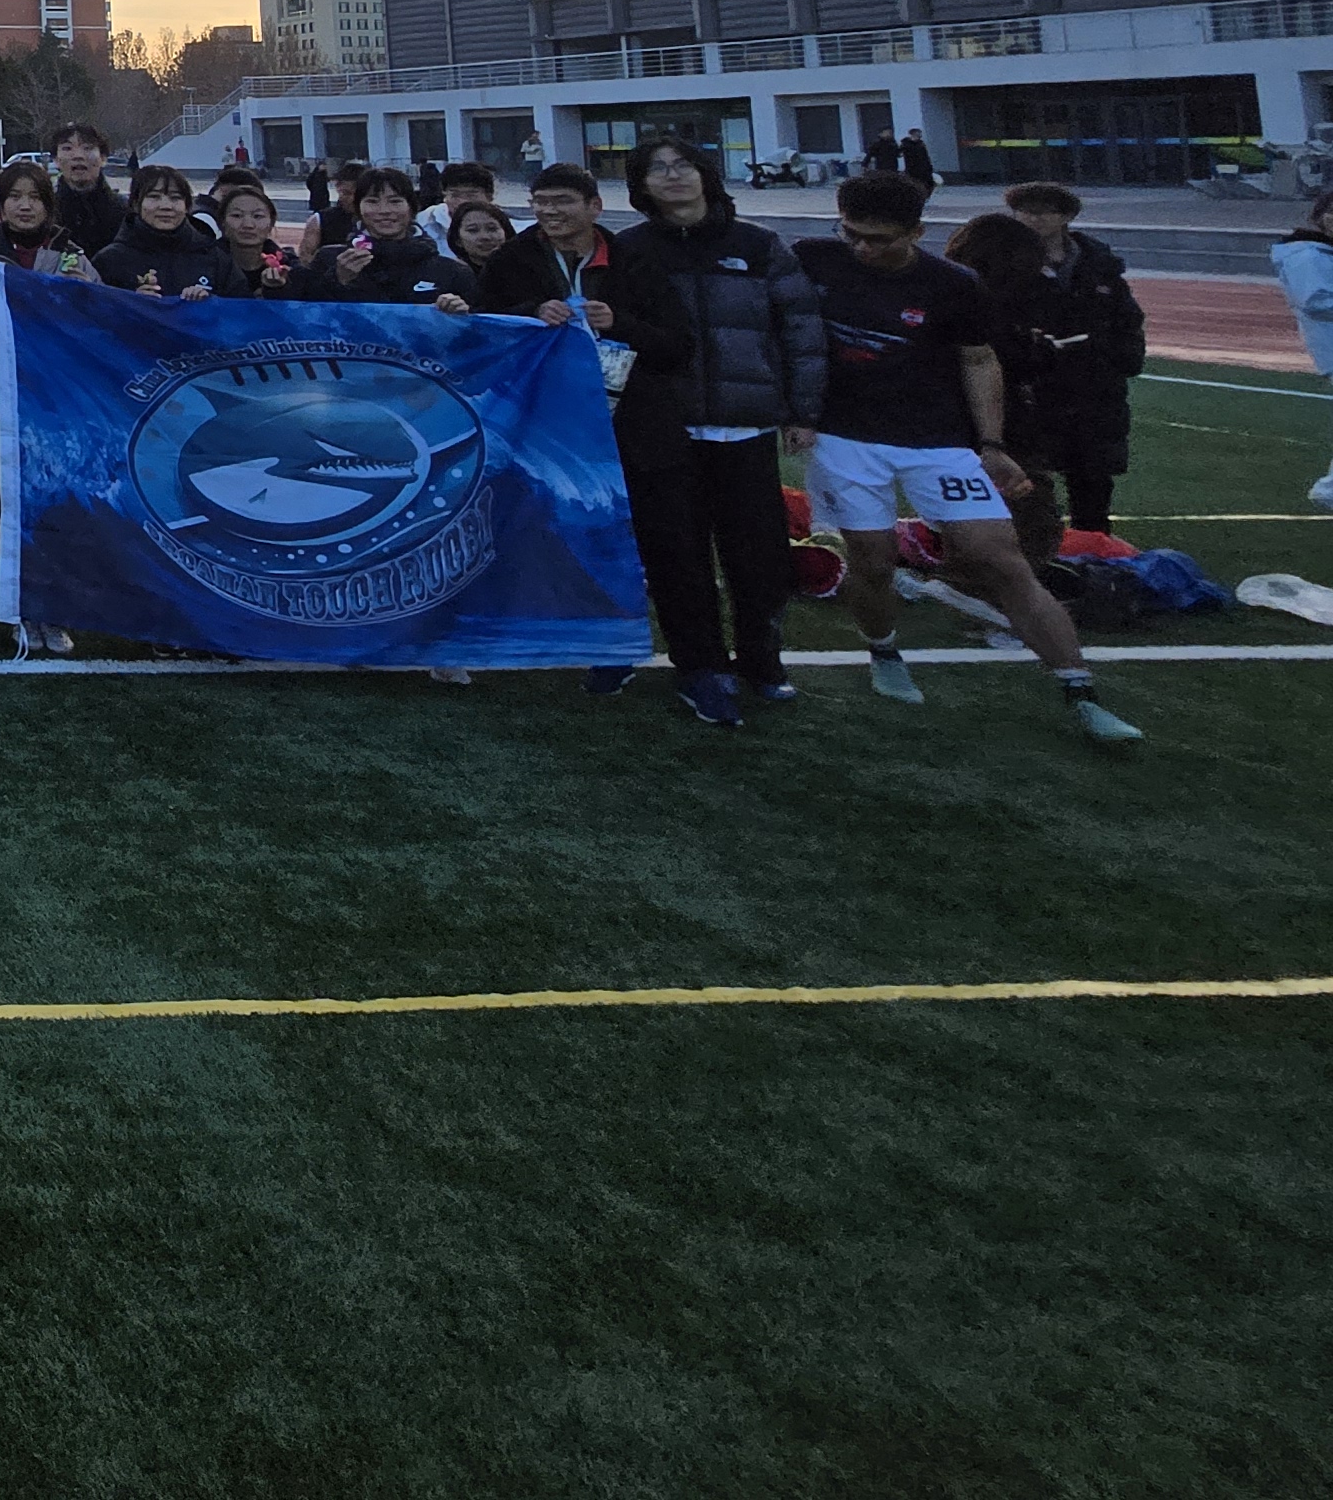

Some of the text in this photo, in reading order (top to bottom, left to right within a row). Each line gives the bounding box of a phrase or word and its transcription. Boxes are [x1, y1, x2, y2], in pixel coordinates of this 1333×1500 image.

[260, 335, 357, 358] University
[938, 477, 991, 501] 89
[282, 566, 399, 621] TOUCH
[395, 485, 494, 609] RUGBY
